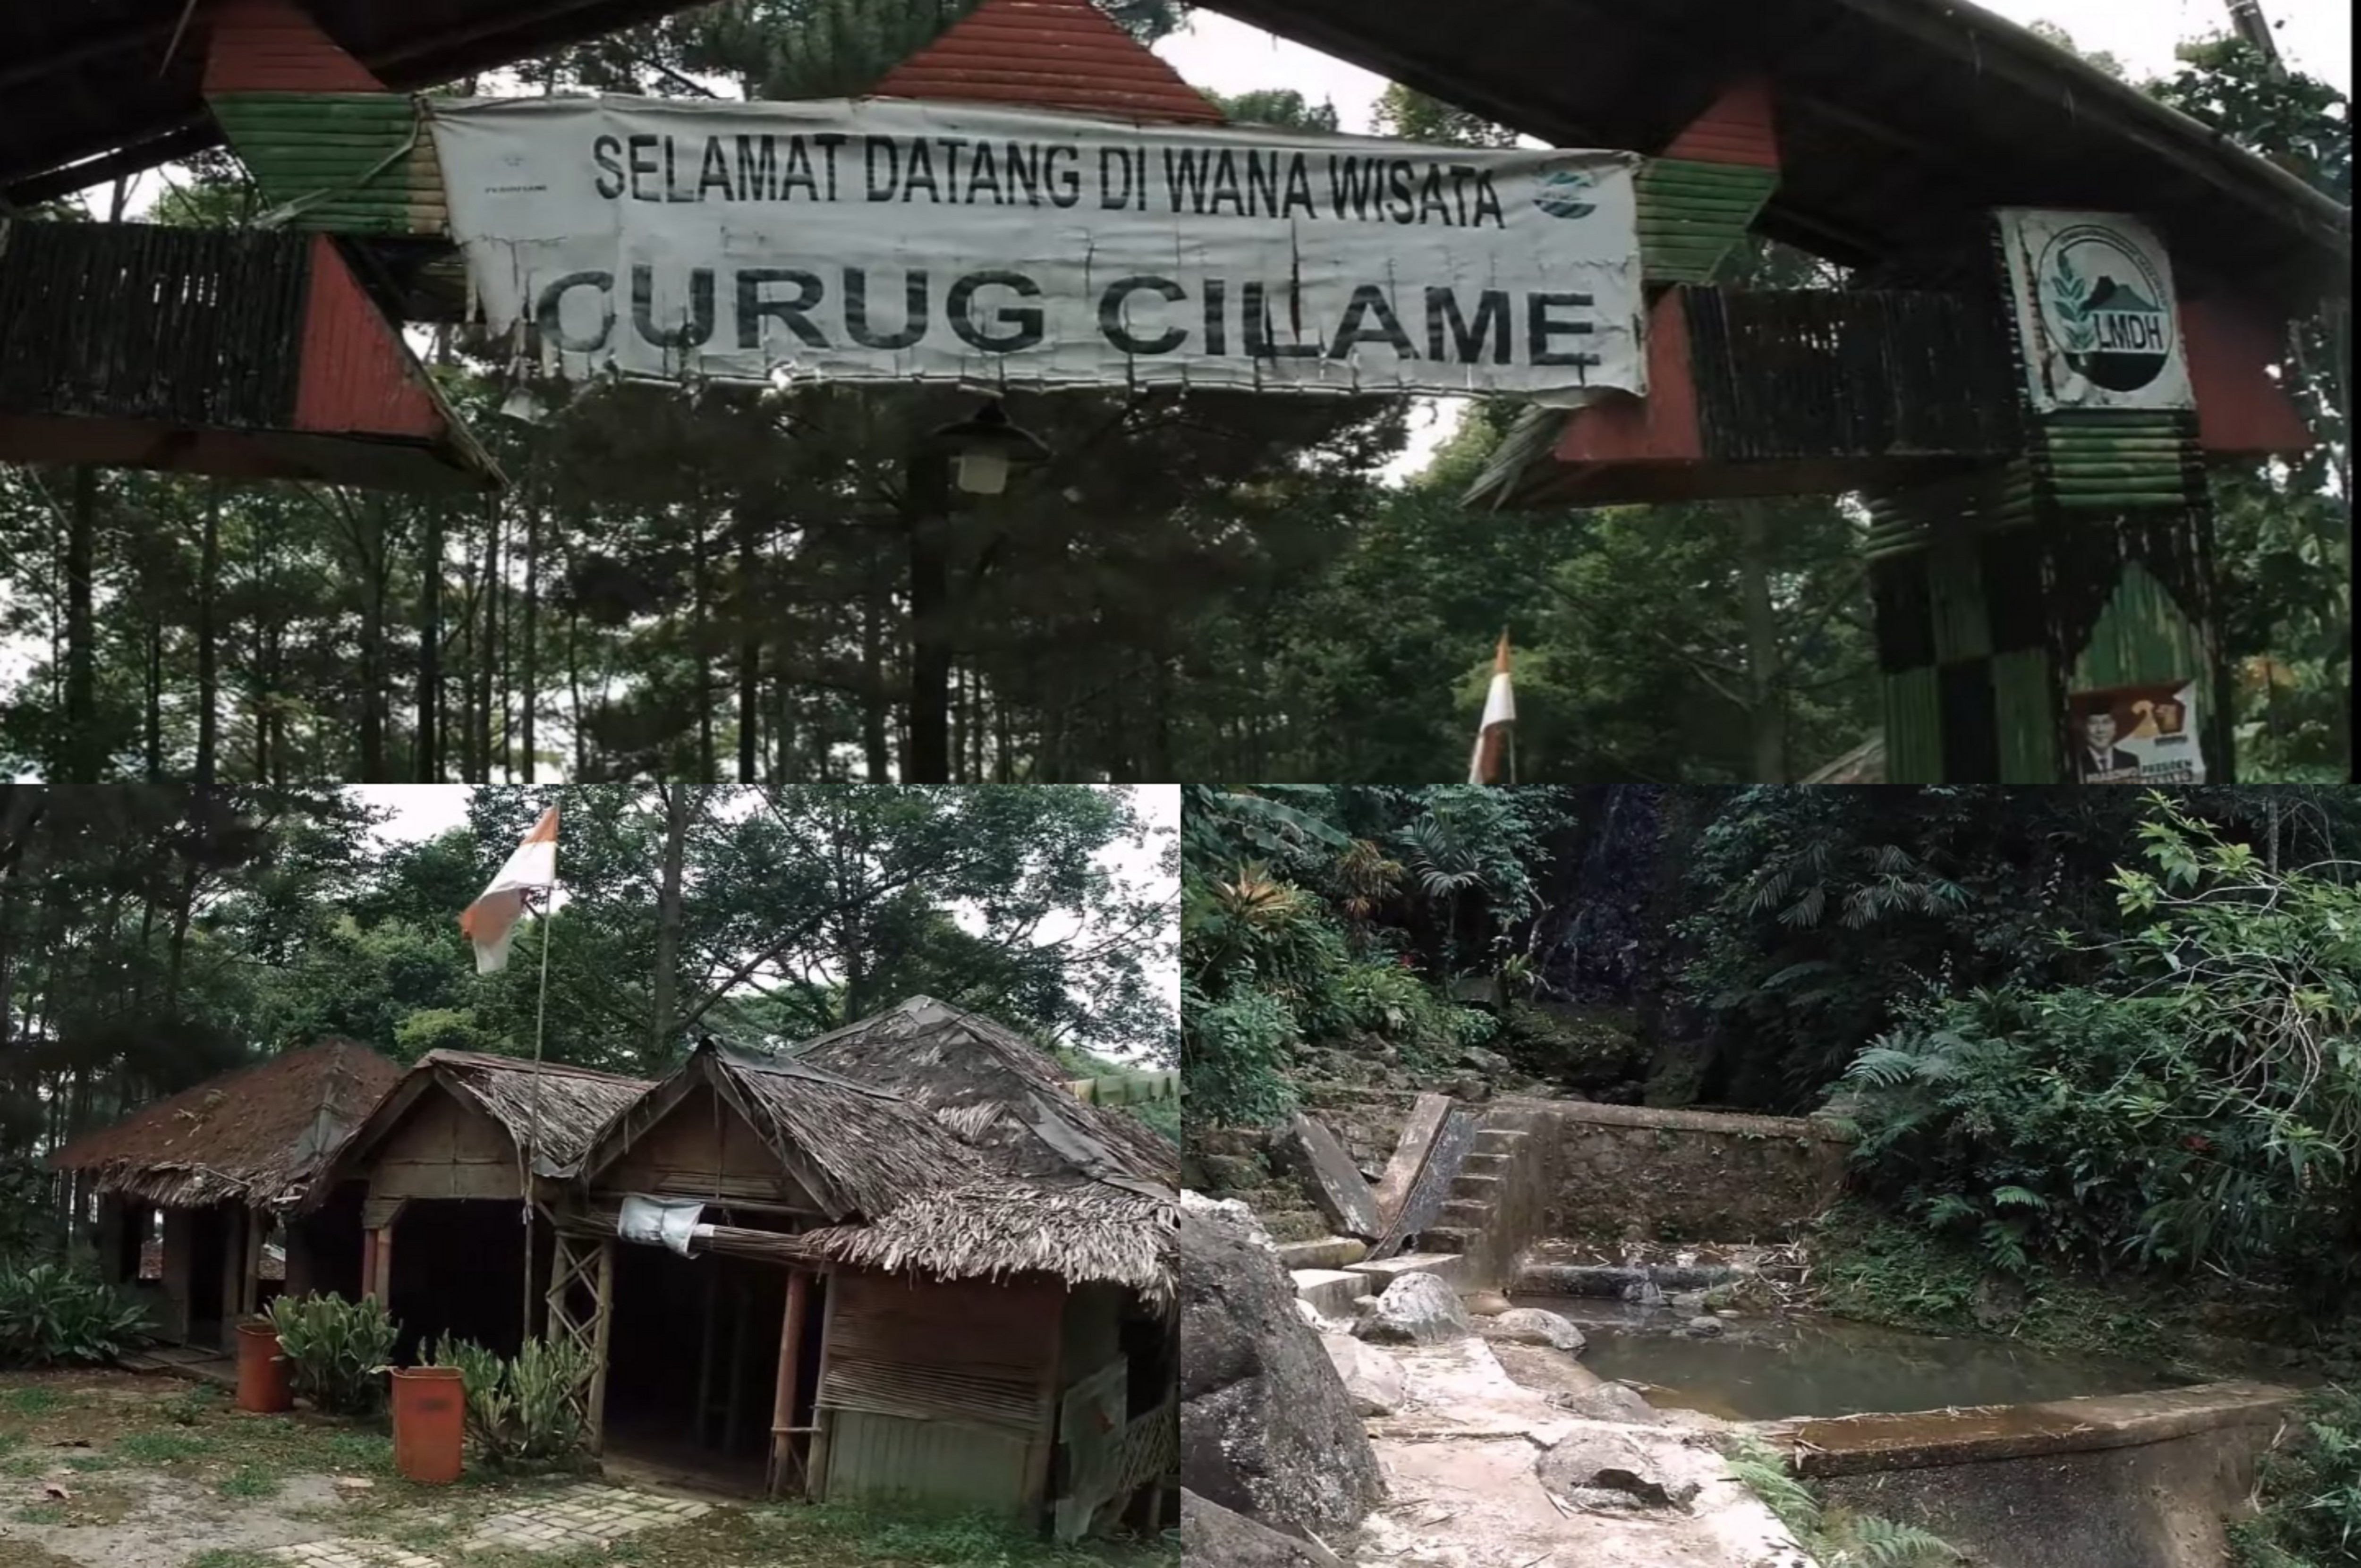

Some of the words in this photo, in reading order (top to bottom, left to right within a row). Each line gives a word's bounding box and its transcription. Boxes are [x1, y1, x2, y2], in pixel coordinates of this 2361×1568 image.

[594, 133, 846, 202] SELAMAT
[865, 135, 1080, 208] DATANG
[1100, 147, 1146, 211] DI
[1164, 147, 1316, 220] WANA
[1329, 155, 1505, 229] WISATA
[536, 267, 1045, 353] CURUG
[1097, 275, 1601, 366] CILAME
[2093, 313, 2163, 351] LMDH
